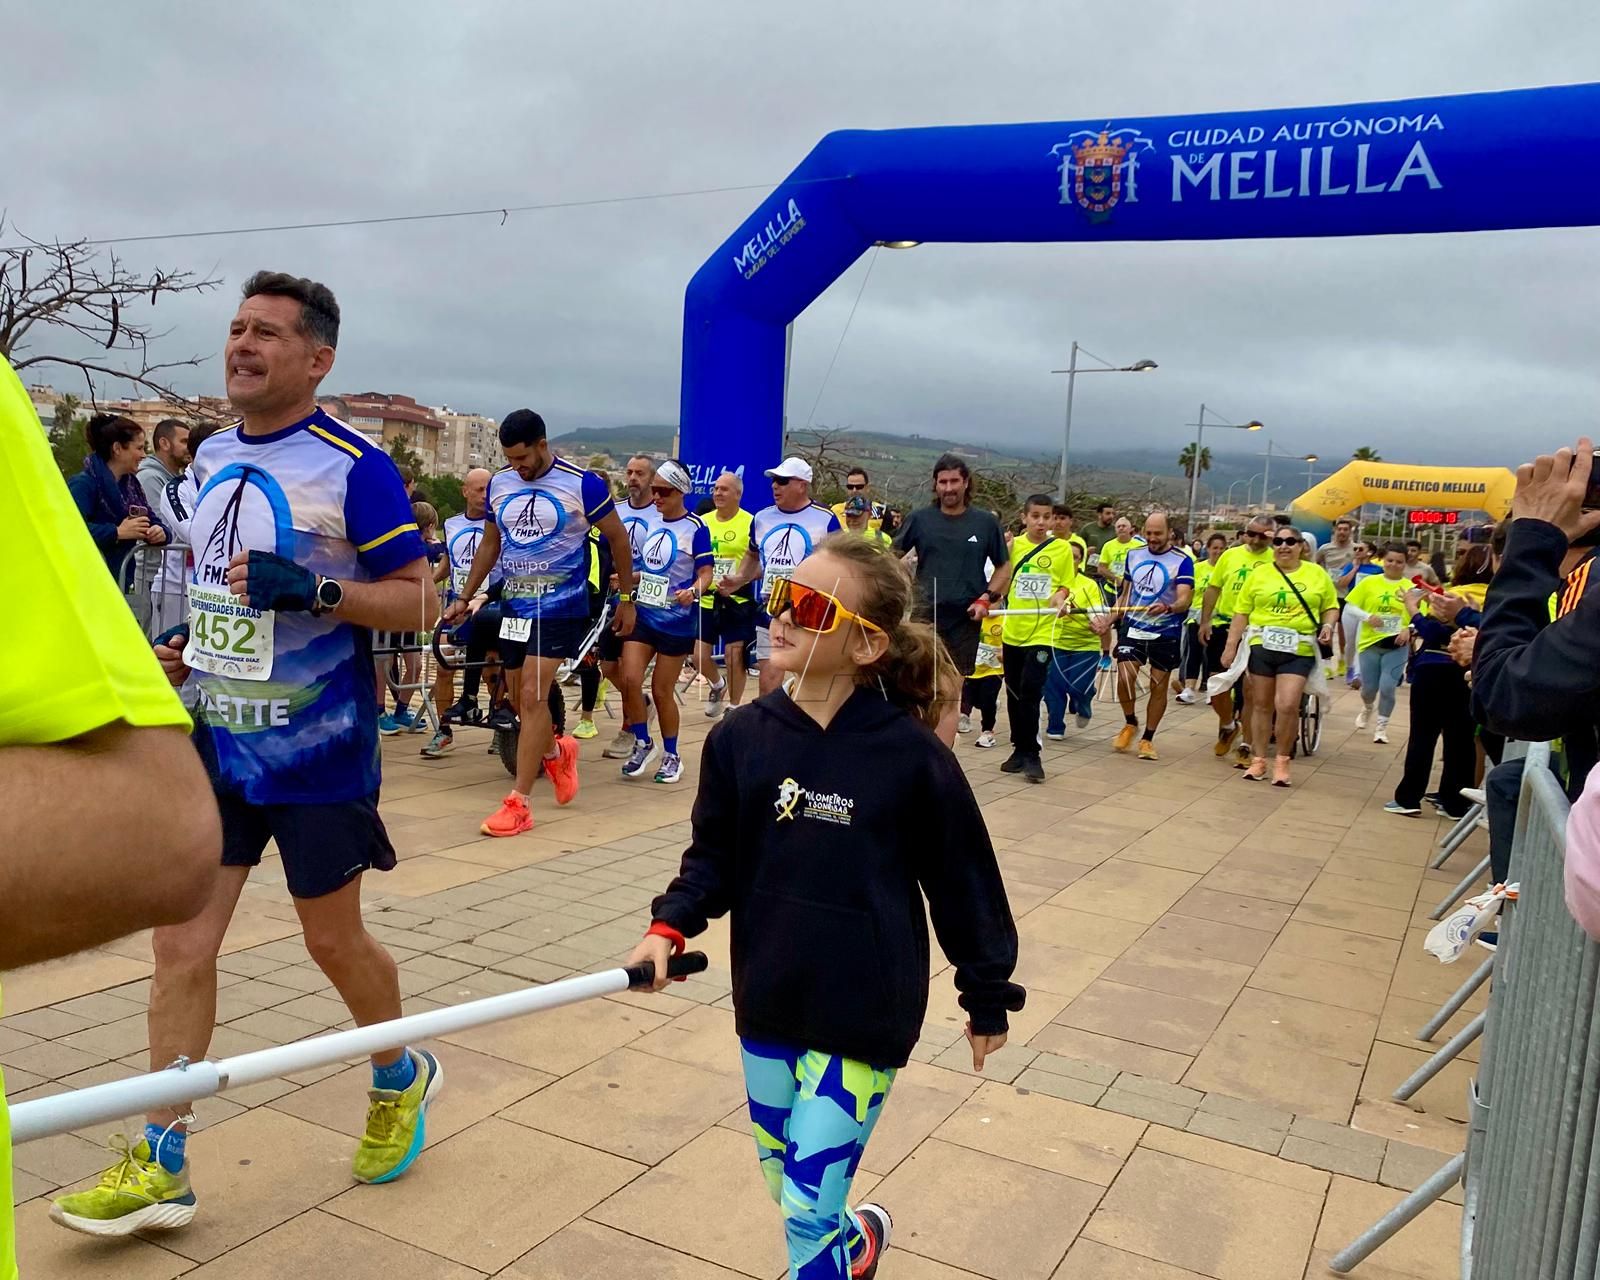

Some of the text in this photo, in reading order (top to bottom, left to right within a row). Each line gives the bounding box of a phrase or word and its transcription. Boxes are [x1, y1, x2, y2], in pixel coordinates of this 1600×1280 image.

[1168, 113, 1445, 147] CIUDAD AUTÓNOMA
[1189, 153, 1205, 165] DE
[1171, 140, 1443, 202] MELILLA
[733, 198, 801, 274] MELILLA
[1363, 477, 1486, 494] CLUB ATLÉTICO MELILLA
[515, 528, 540, 537] FMEM
[770, 557, 792, 566] FMEM
[203, 564, 230, 586] FME
[641, 581, 662, 597] 390
[1022, 580, 1048, 592] 207
[197, 591, 227, 604] CARRERA
[191, 598, 262, 619] ENFERMEDADES RARAS
[195, 611, 256, 655] 452
[1268, 633, 1293, 645] 431
[981, 650, 996, 661] 22
